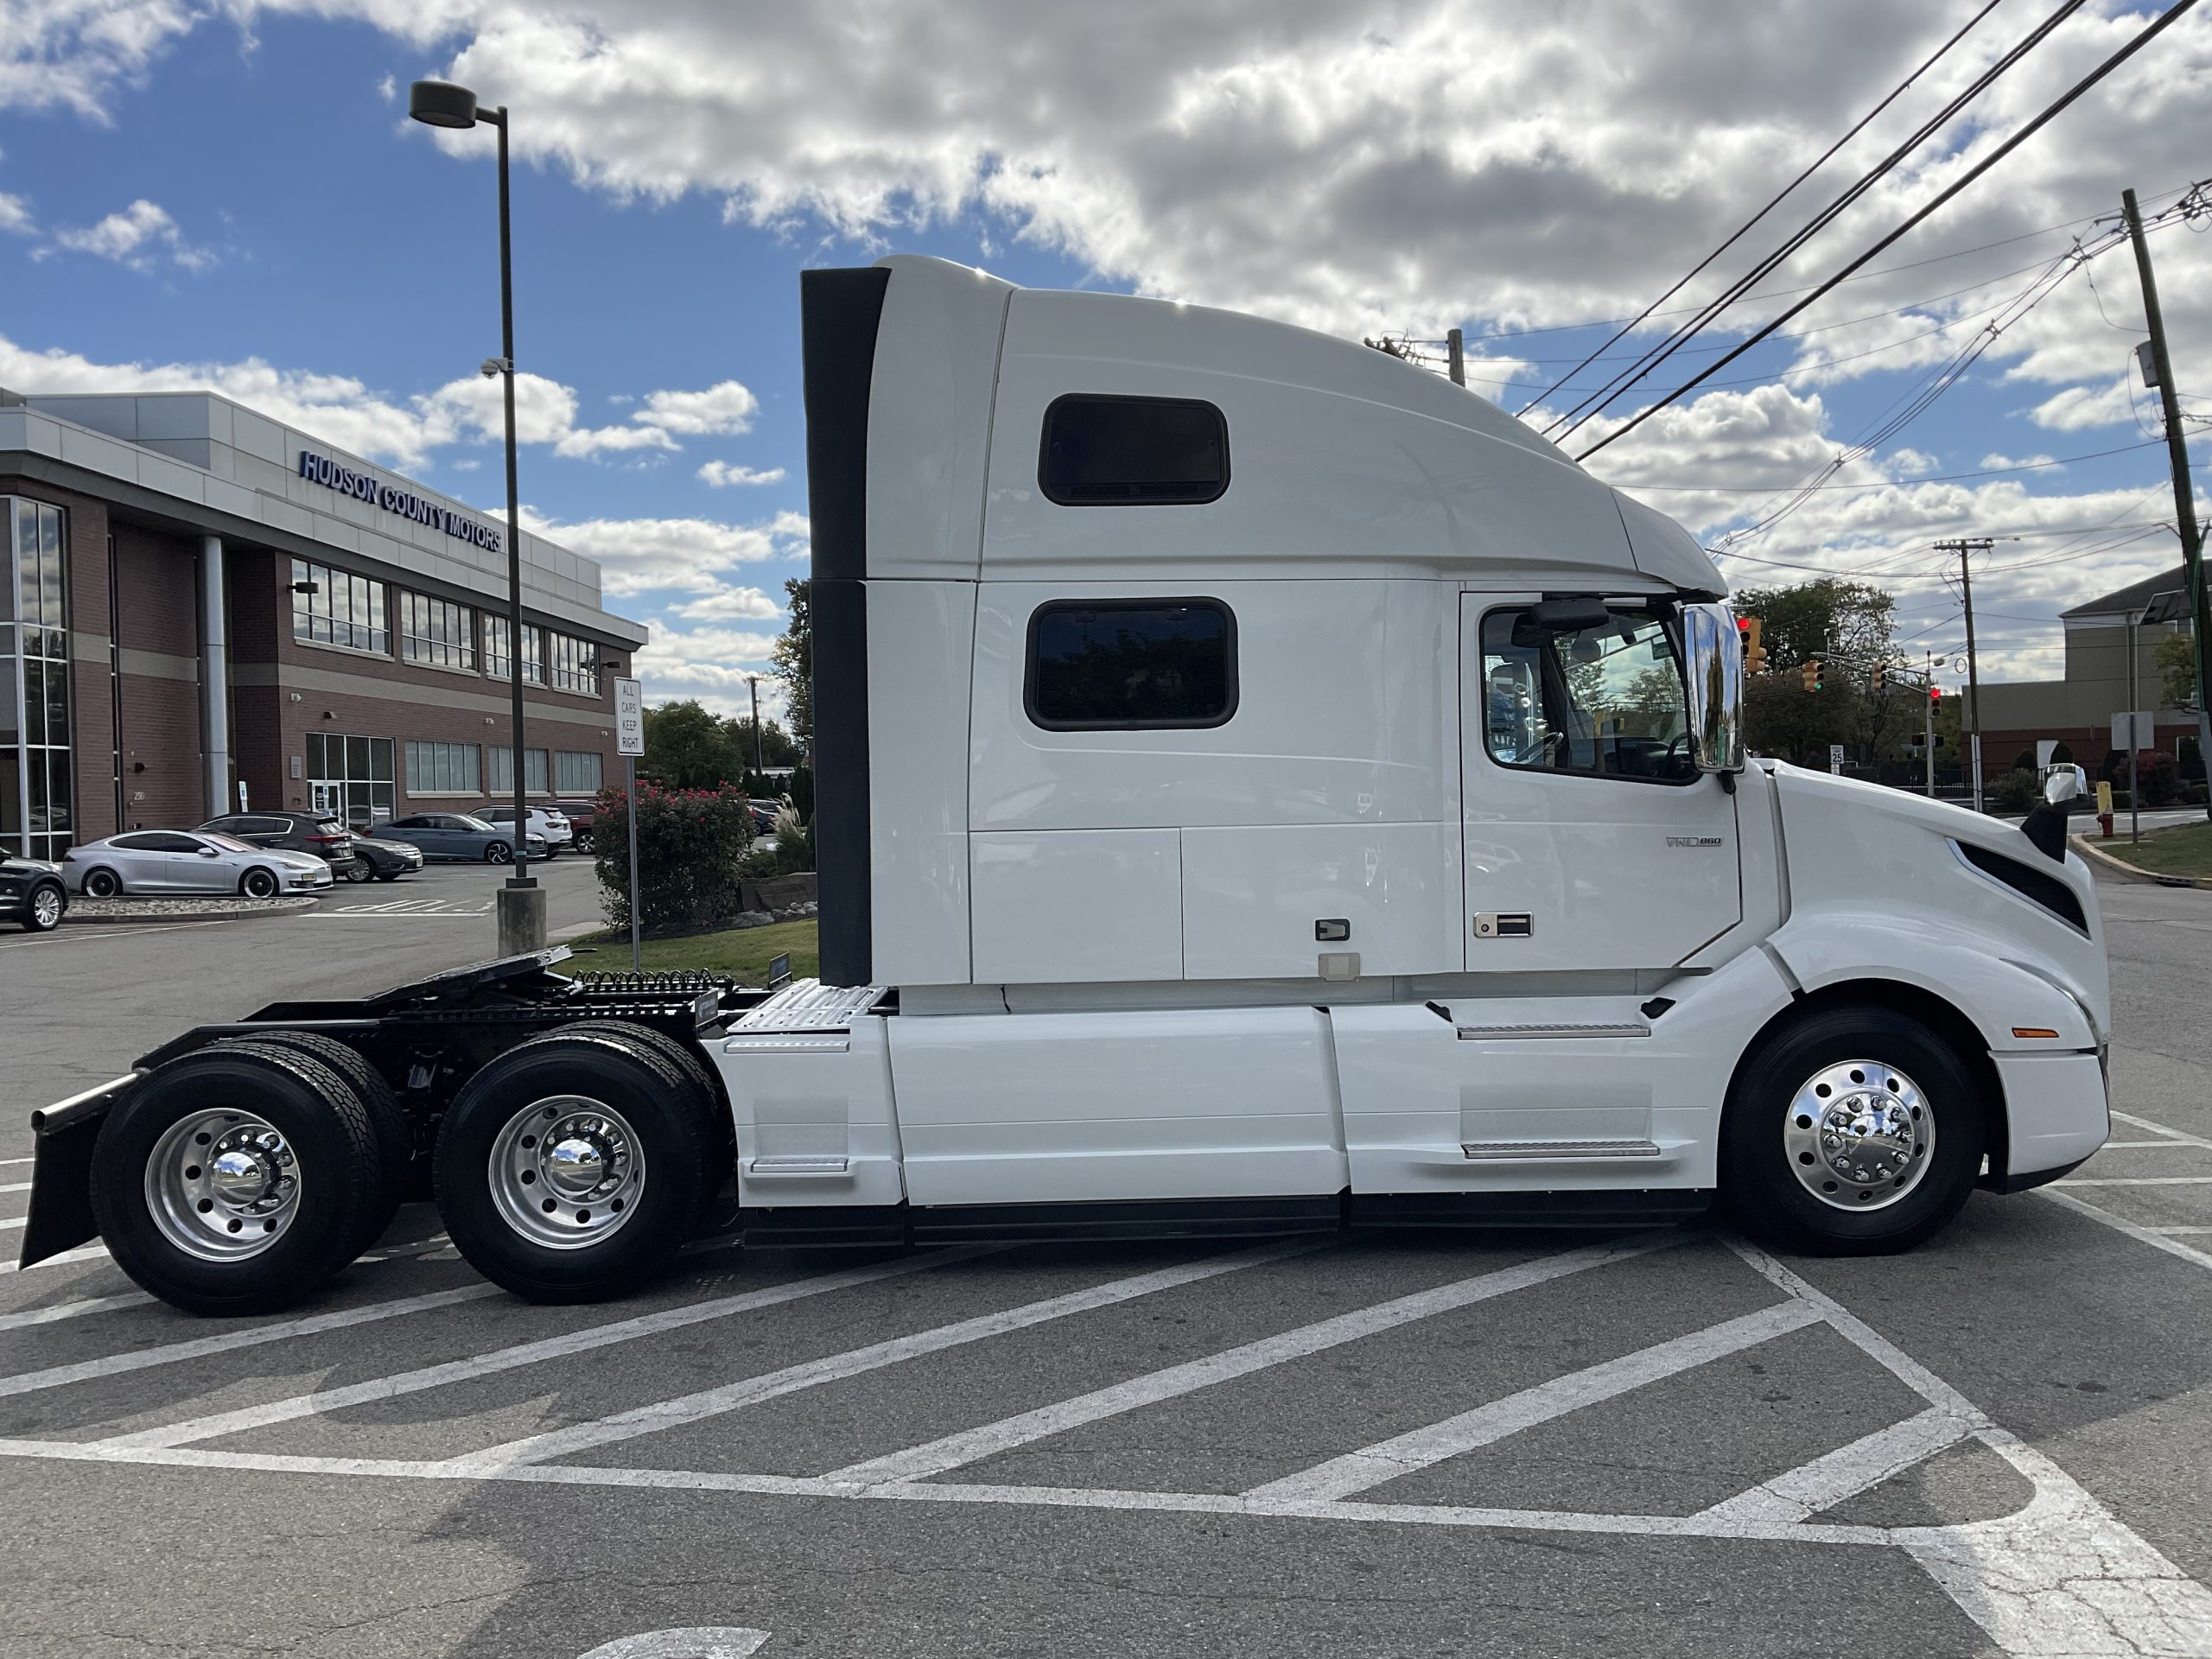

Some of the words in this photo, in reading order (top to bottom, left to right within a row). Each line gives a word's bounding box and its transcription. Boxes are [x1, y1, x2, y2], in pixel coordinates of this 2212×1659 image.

[300, 450, 379, 505] HUDSON
[381, 486, 447, 530] COUNTY
[445, 512, 501, 553] MOTORS
[622, 683, 634, 696] ALL
[621, 702, 637, 714] CARS
[622, 719, 637, 731] KEEP
[622, 737, 639, 749] RIGHT
[1833, 753, 1842, 762] 25
